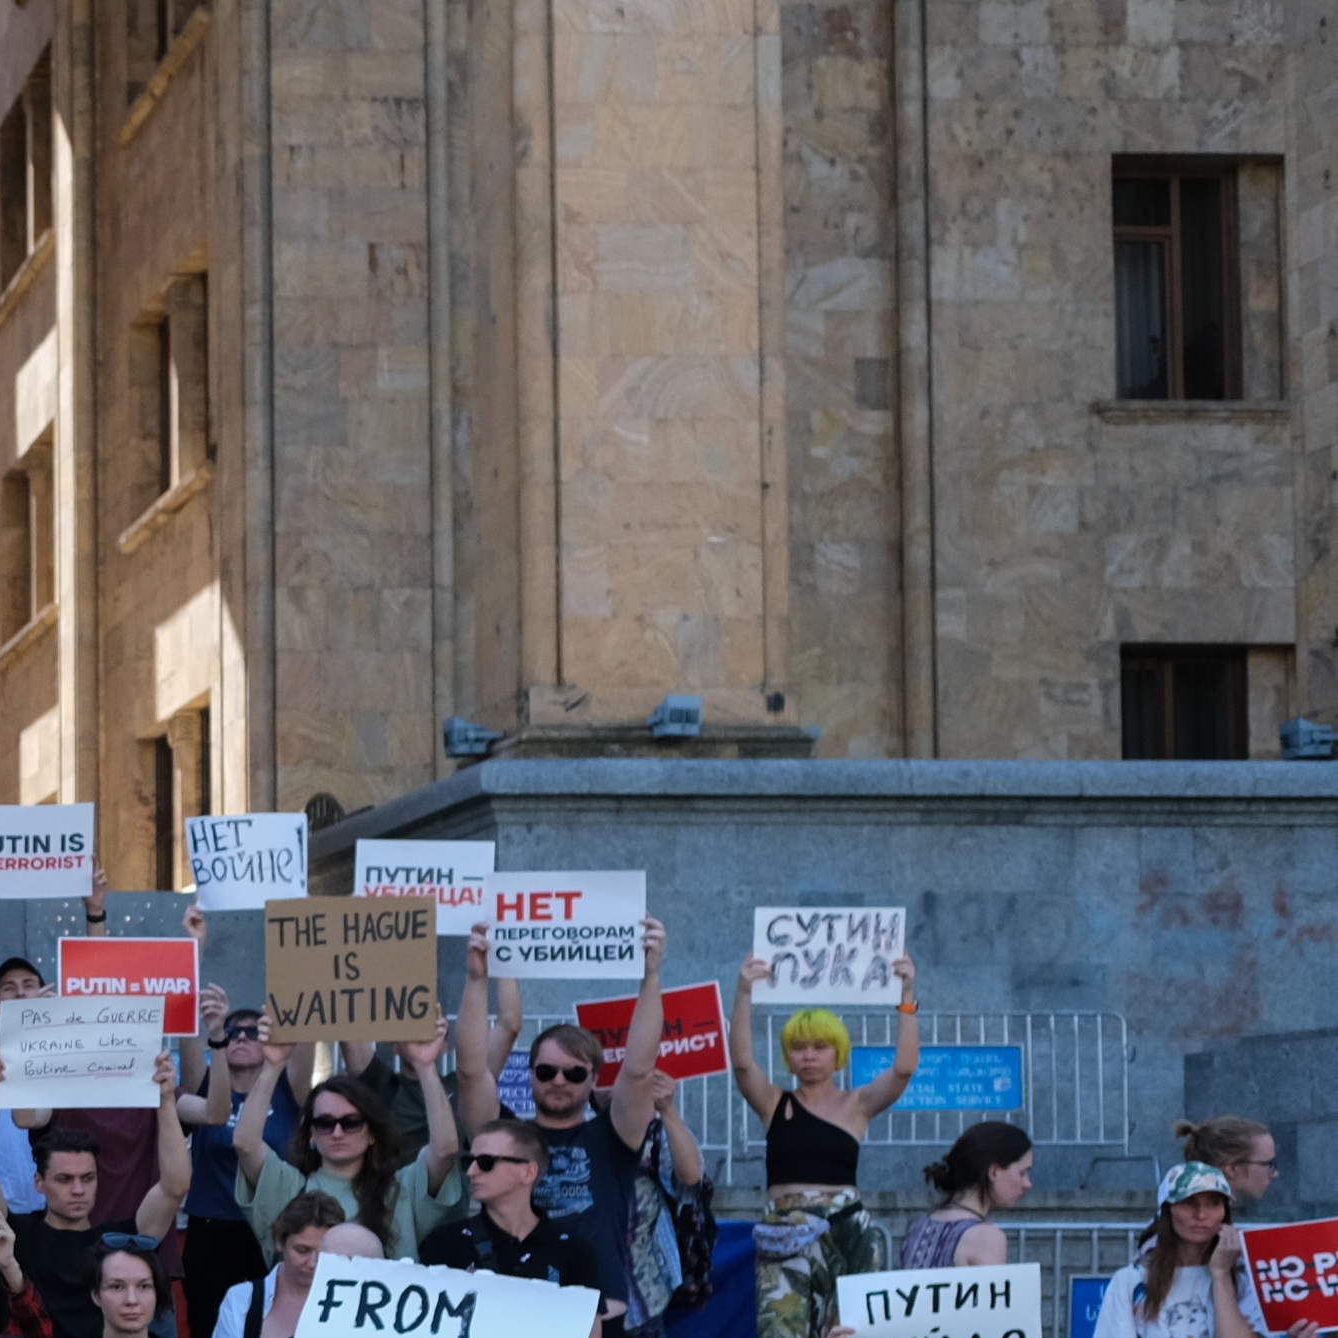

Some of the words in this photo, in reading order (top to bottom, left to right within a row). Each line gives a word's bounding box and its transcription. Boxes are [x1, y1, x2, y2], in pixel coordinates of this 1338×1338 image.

[60, 833, 85, 852] IS
[189, 819, 253, 853] НЕТ
[366, 866, 454, 885] ПУТИН
[496, 891, 582, 921] НЕТ
[268, 914, 327, 947] THE
[343, 909, 428, 944] HAGUE
[495, 925, 635, 941] ПЕРЕГОВОРАМ
[766, 912, 899, 951] СУТИН
[334, 951, 360, 980] IS
[496, 945, 511, 962] С
[520, 941, 634, 963] УБИЙЦЕЙ
[768, 944, 891, 990] ПУКА
[66, 977, 126, 994] PUTIN
[143, 976, 191, 994] WAR
[20, 1009, 52, 1025] PAS
[65, 1012, 85, 1024] de
[96, 1007, 161, 1024] GUERRE
[269, 985, 430, 1026] WAITING
[1256, 1256, 1305, 1281] NO
[866, 1280, 1012, 1325] ПУТИН
